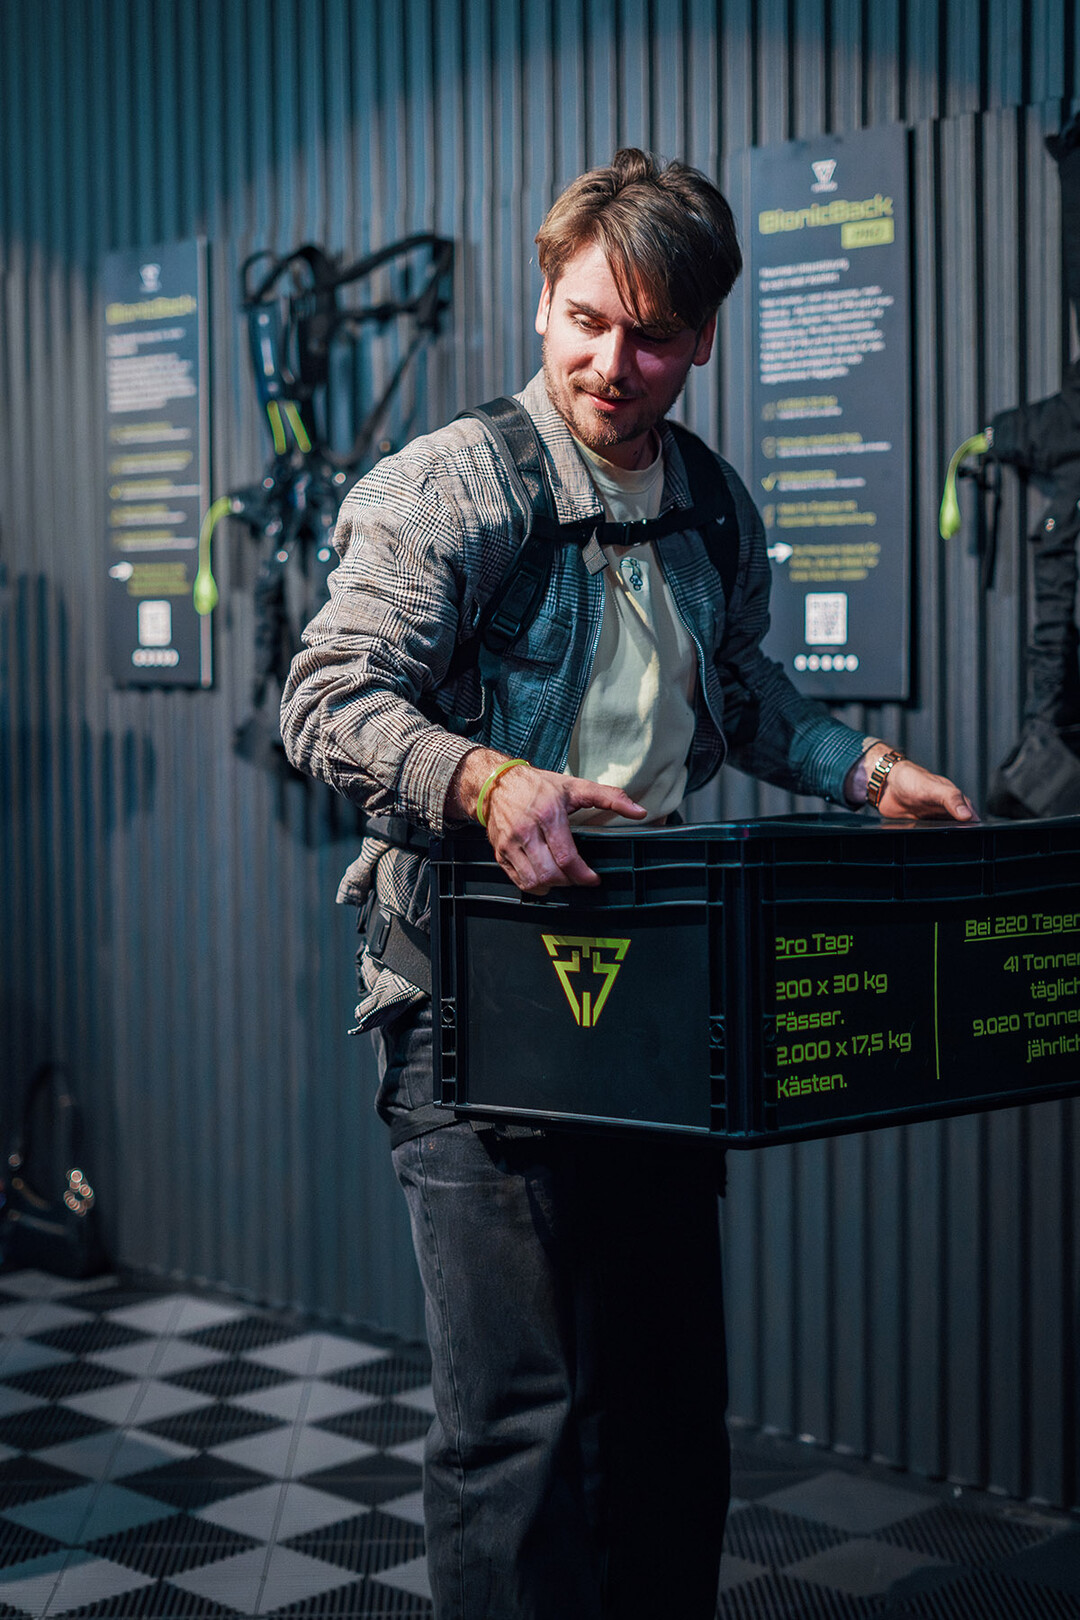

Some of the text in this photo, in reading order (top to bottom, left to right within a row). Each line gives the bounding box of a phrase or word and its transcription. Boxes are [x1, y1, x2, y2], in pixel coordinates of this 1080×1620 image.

[966, 917, 990, 936] Bei
[995, 916, 1028, 934] 220
[776, 934, 853, 955] Pro Tag:
[1004, 956, 1018, 972] 41
[817, 980, 828, 995] x
[834, 974, 858, 993] 30
[864, 971, 887, 993] kg
[776, 1011, 844, 1032] Fässer.
[973, 1010, 1080, 1036] 9.020 Tonne
[777, 1031, 911, 1065] 2.000 x 17,5 kg
[778, 1074, 847, 1098] Kästen.
